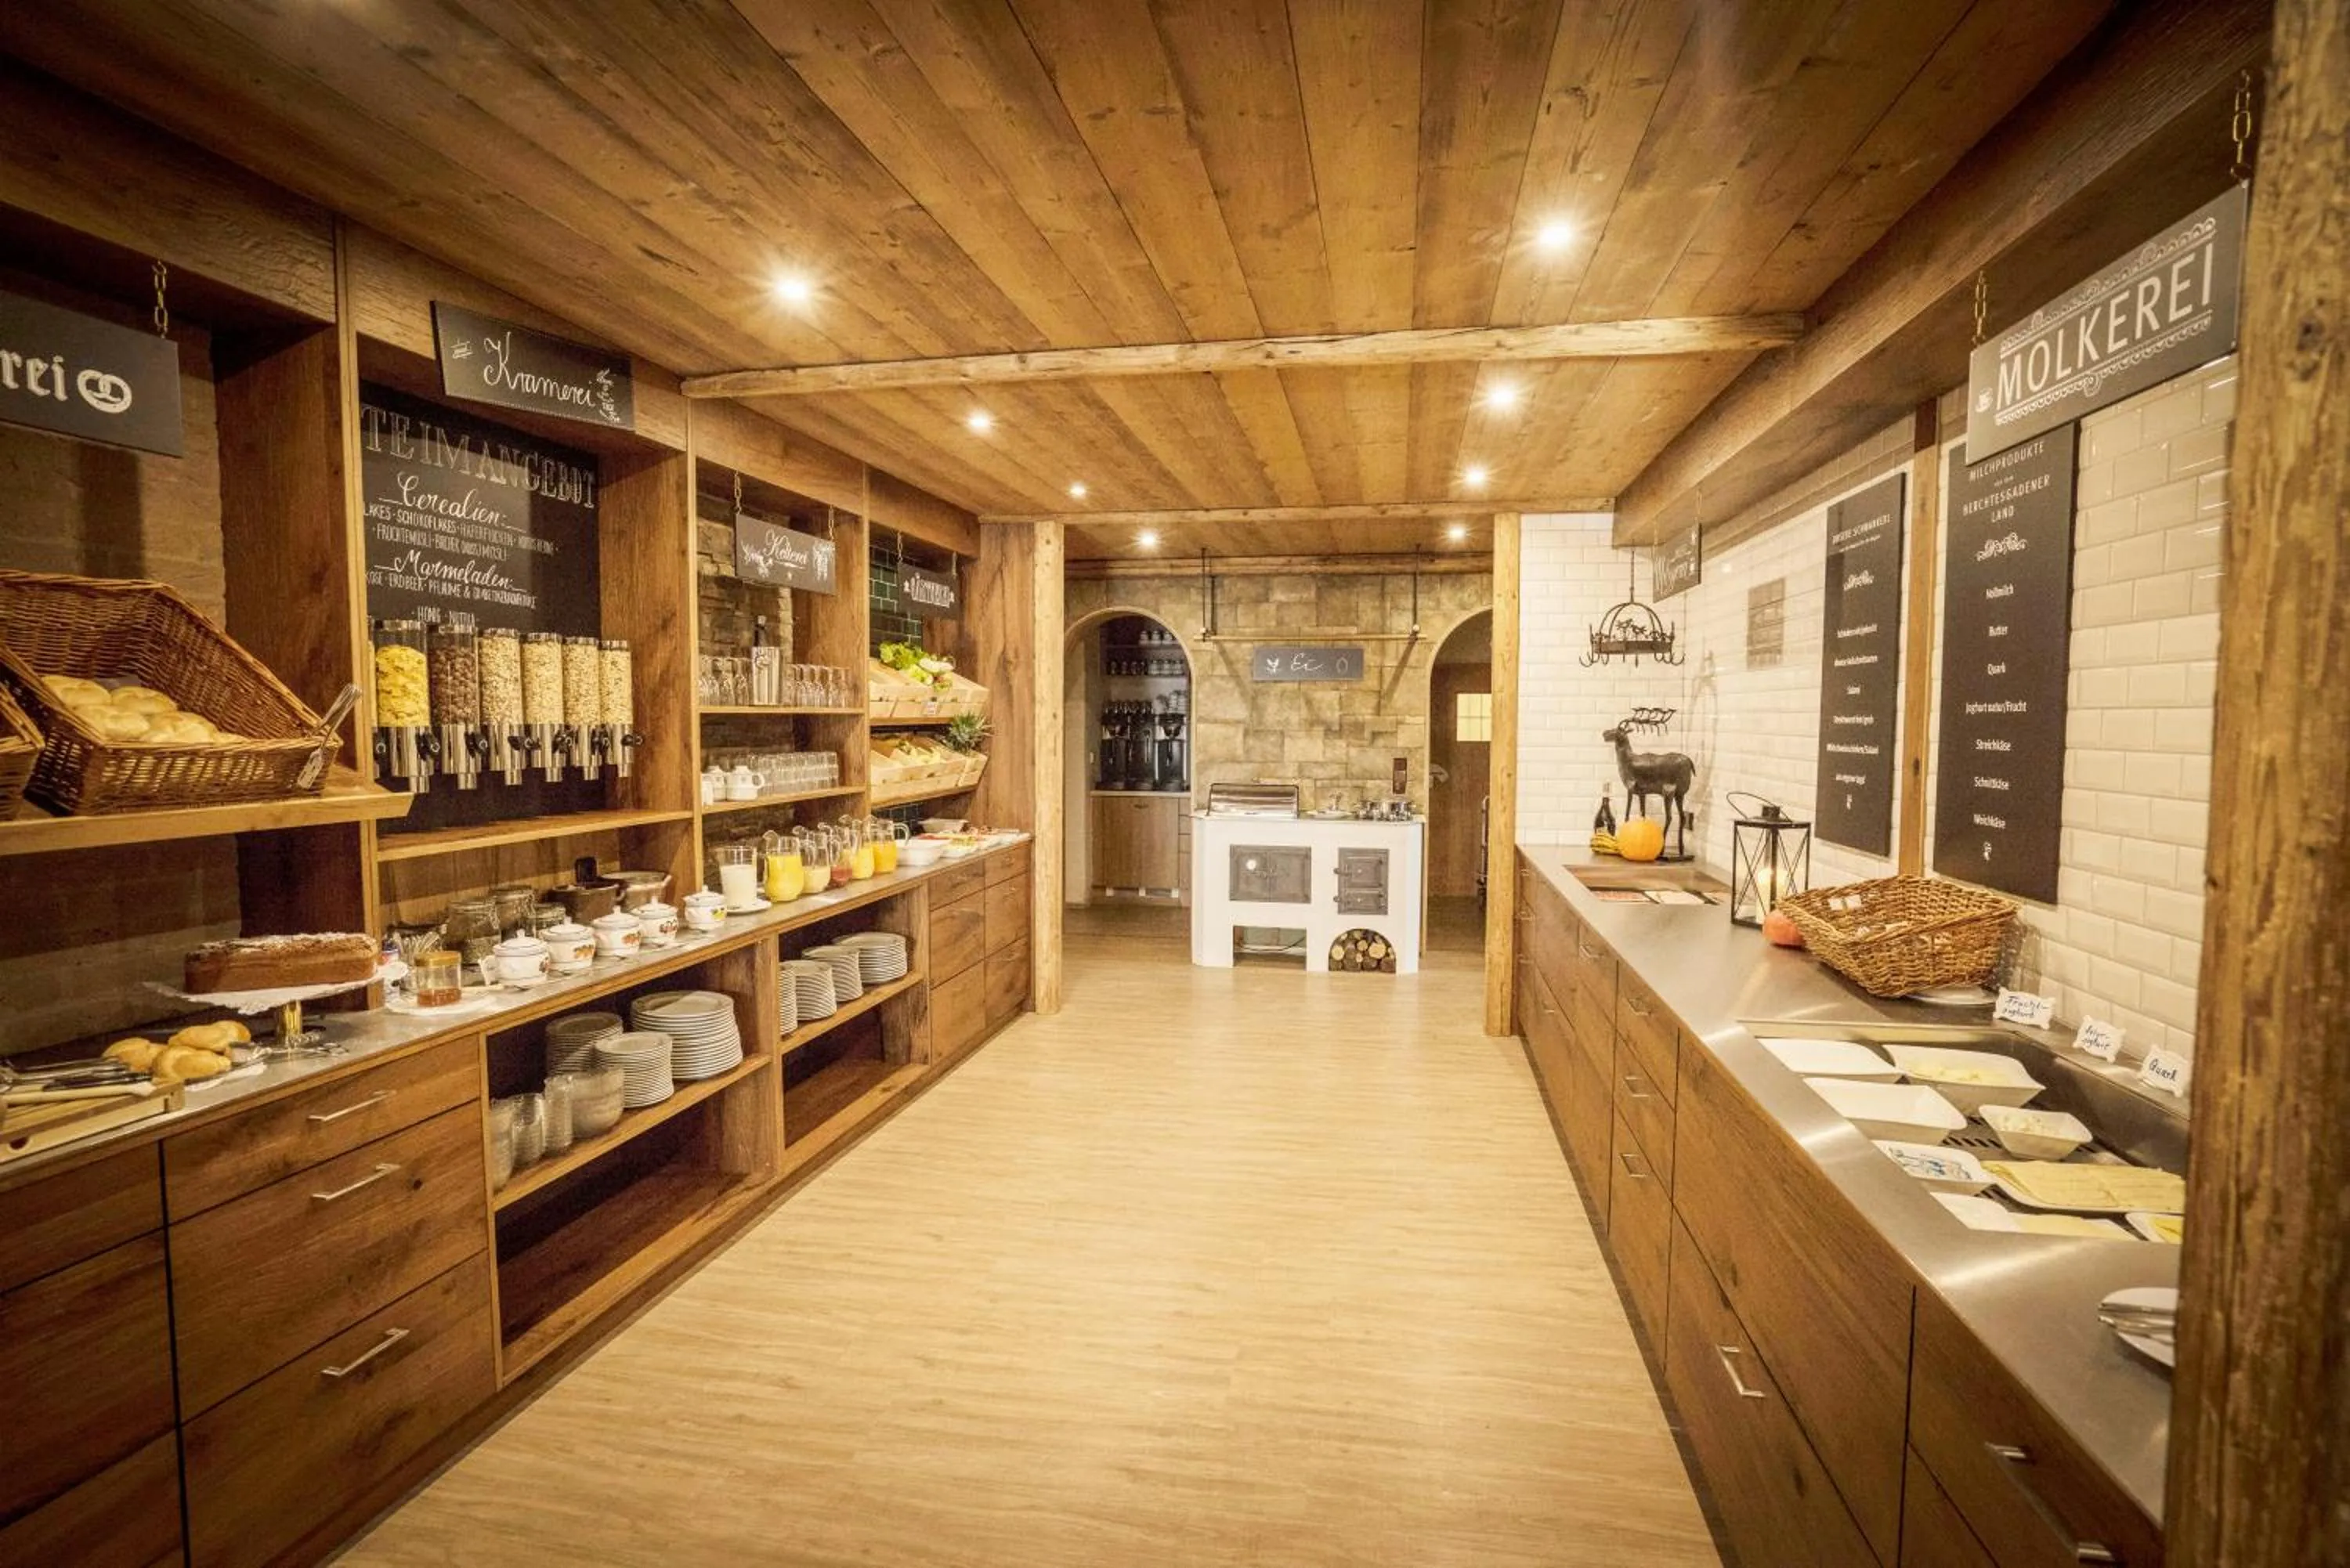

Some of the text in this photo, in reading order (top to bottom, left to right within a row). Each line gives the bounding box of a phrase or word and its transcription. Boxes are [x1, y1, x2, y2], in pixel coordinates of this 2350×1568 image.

[1996, 242, 2214, 410] MOLKEREI
[483, 331, 596, 407] Kramerei
[475, 439, 595, 509] ANGEBOT
[1969, 441, 2044, 482] MILCHPRODUKTE
[1962, 474, 2051, 517] BERCHTESGADENER
[1991, 505, 2015, 522] LAND
